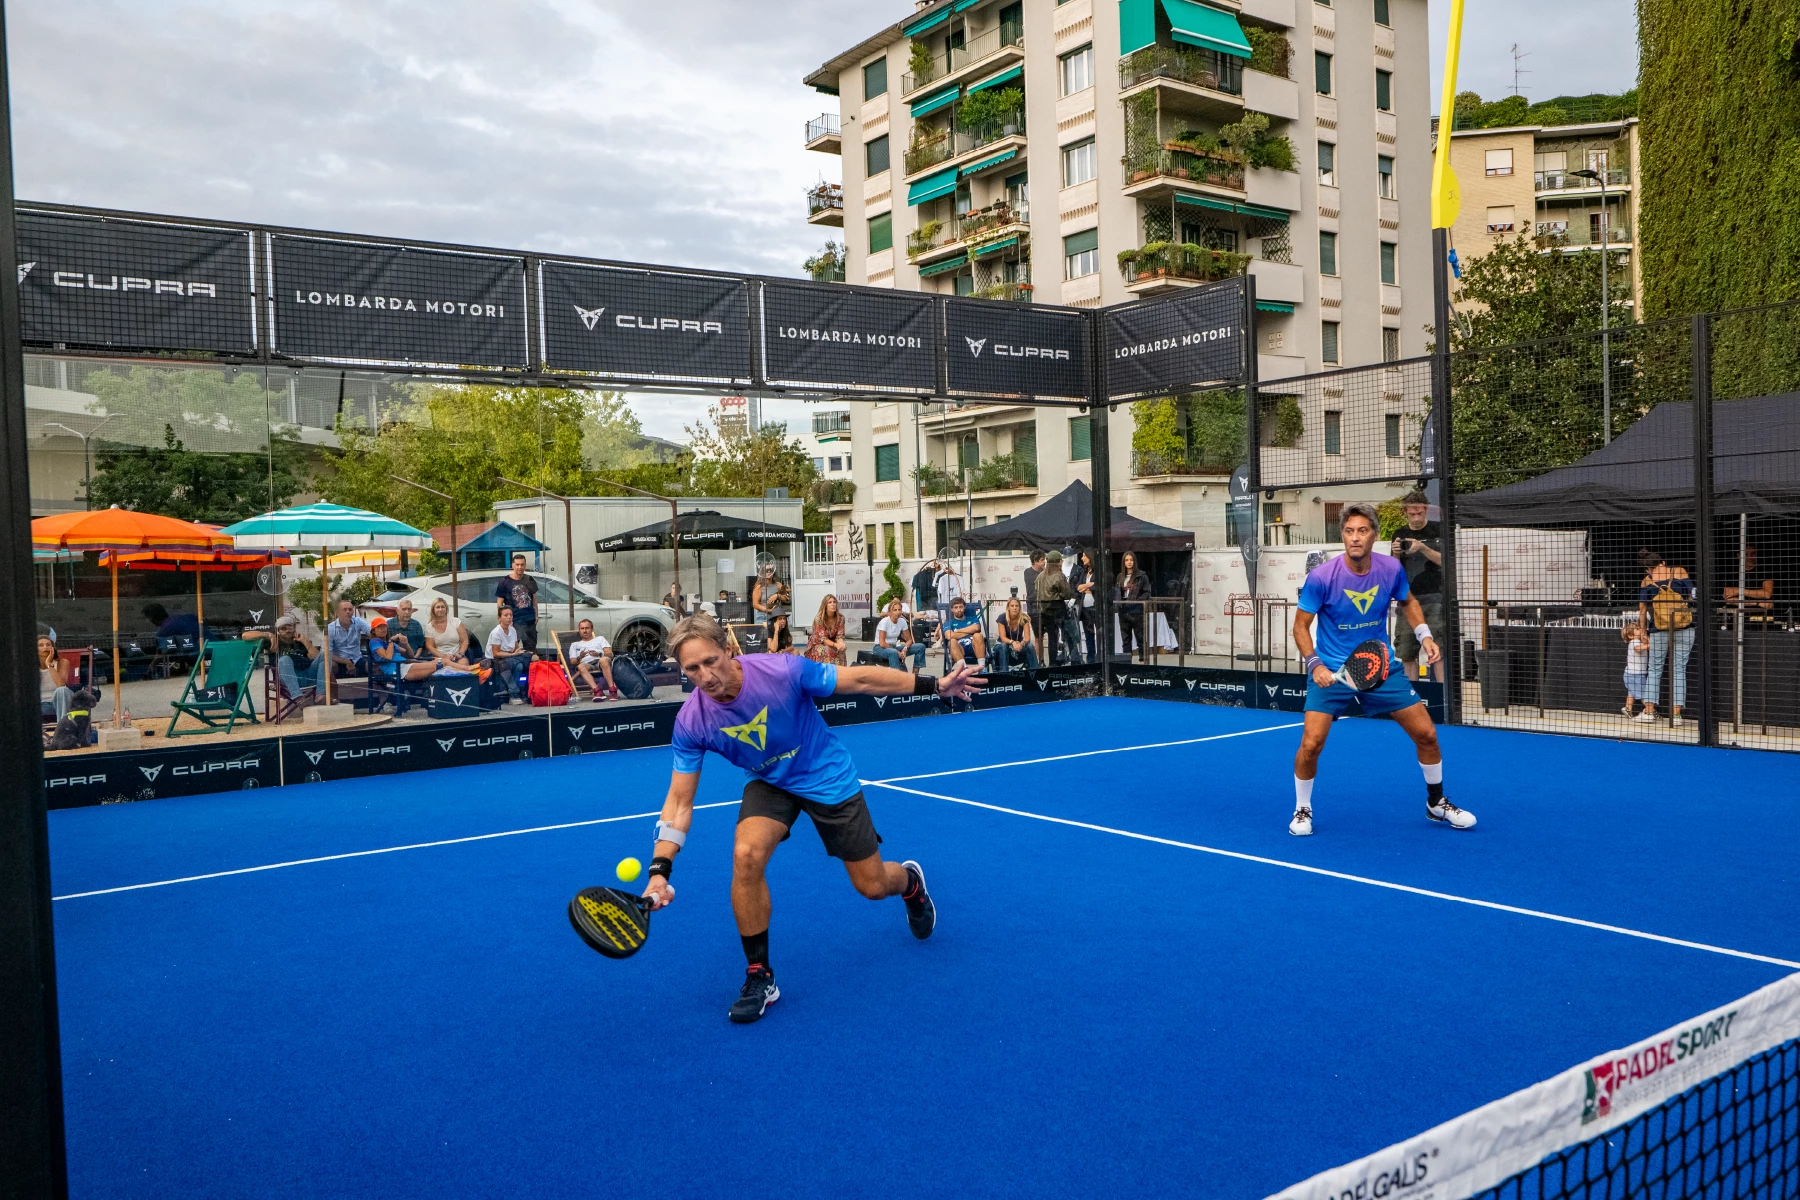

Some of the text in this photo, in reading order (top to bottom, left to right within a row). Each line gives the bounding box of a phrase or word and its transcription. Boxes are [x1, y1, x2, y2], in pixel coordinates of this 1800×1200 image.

[54, 271, 216, 298] CUPRA
[296, 290, 504, 318] LOMBARDA MOTORI
[615, 314, 722, 334] CUPRA
[779, 326, 921, 349] LOMBARDA MOTORI
[1114, 326, 1231, 359] LOMBARDA MOTORI
[994, 344, 1070, 360] CUPRA
[604, 538, 623, 548] CUPRA
[683, 532, 724, 540] CUPRA
[978, 684, 1022, 695] CUPRA
[1052, 677, 1094, 688] CUPRA
[1130, 678, 1171, 687] CUPRA
[1200, 683, 1245, 693] CUPRA
[892, 693, 941, 704] CUPRA
[1282, 688, 1308, 697] CUP
[814, 701, 857, 712] UPRA
[592, 721, 655, 735] CUPRA
[463, 733, 533, 748] CUPRA
[333, 745, 411, 760] CUPRA
[751, 744, 801, 772] UPR
[172, 758, 260, 776] CUPRA
[45, 773, 107, 789] PRA
[1616, 1010, 1738, 1090] PADELSPORT
